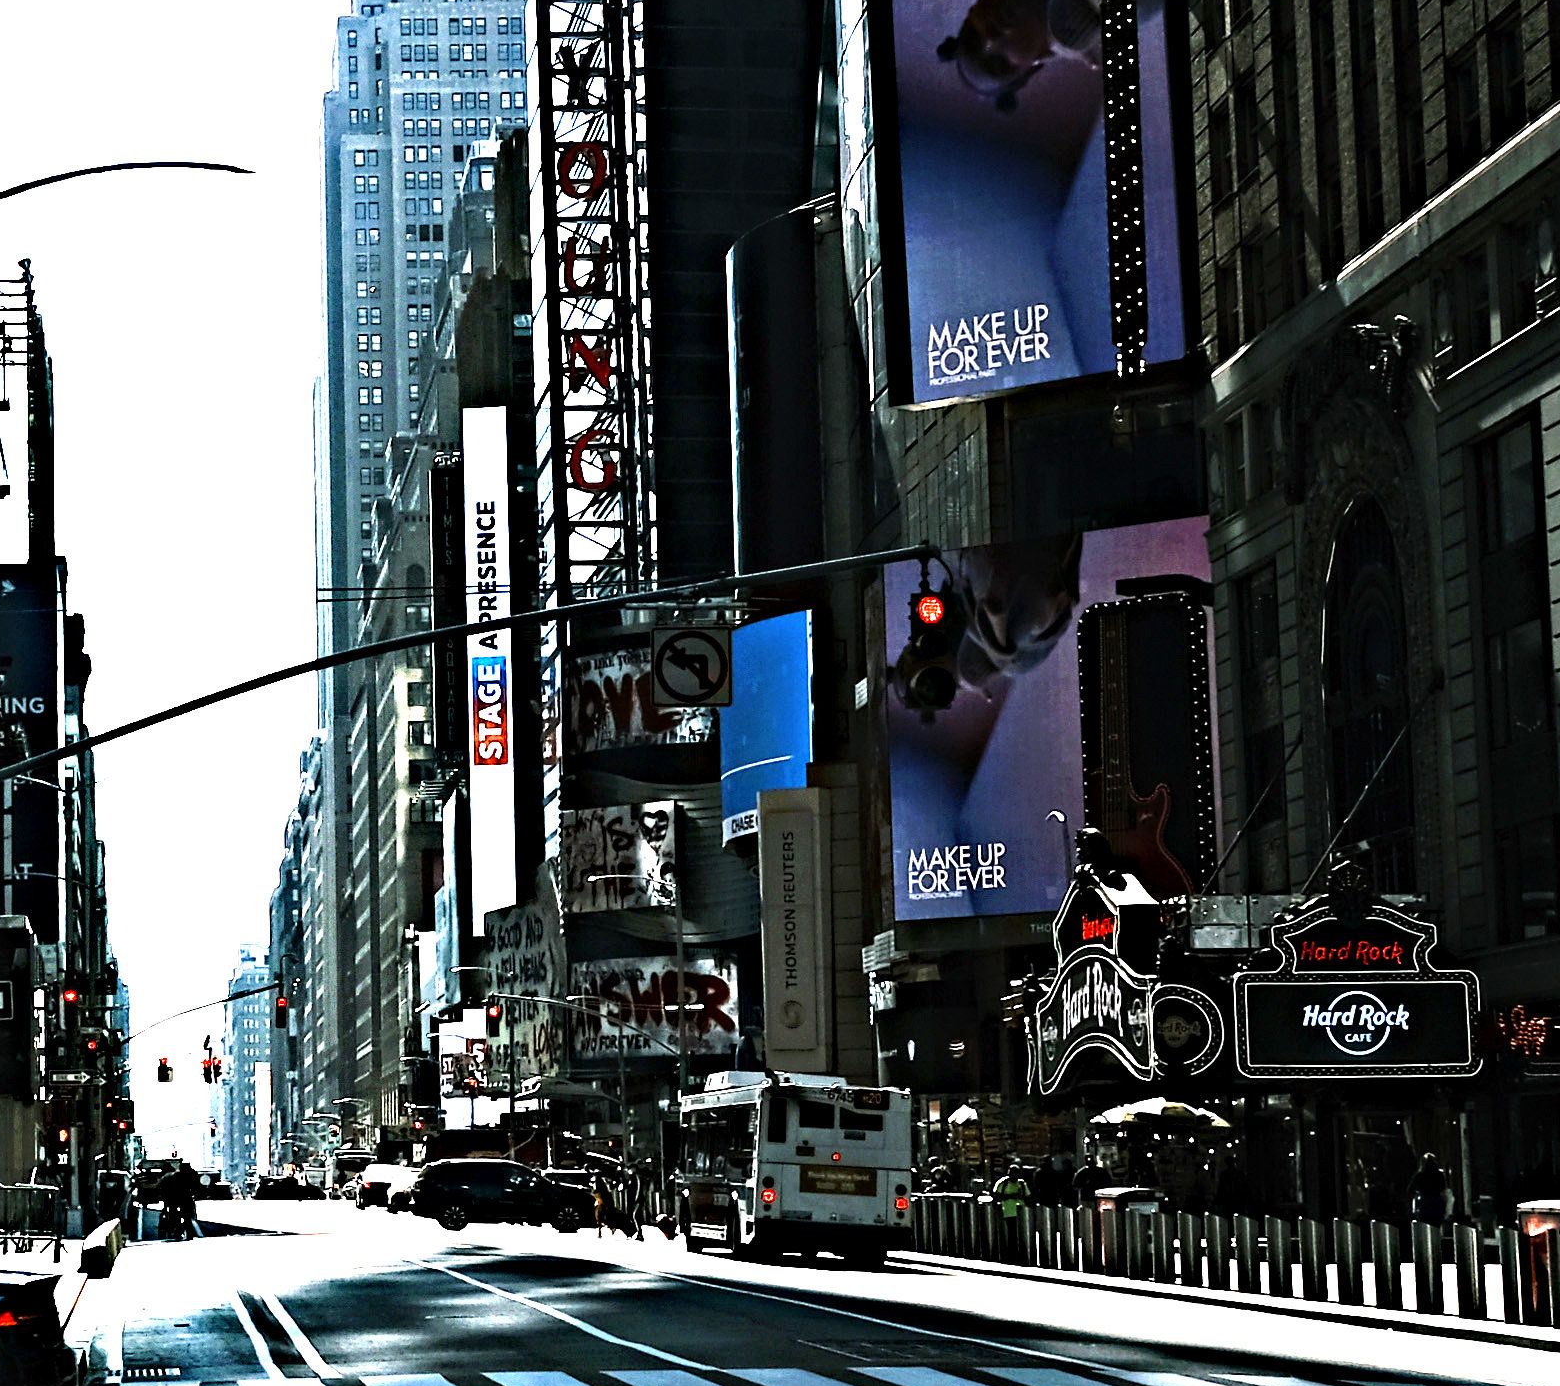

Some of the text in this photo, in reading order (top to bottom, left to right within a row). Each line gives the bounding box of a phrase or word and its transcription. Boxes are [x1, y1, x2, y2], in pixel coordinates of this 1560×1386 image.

[555, 43, 620, 494] YOUNG
[928, 302, 1050, 352] MAKE UP
[928, 329, 1051, 379] FOR EVER
[477, 663, 505, 761] STAGE
[908, 841, 1006, 872] MAKE UP
[908, 866, 1007, 895] FOR EVER
[783, 838, 798, 993] THOMSON REUTERS
[1299, 939, 1404, 967] Hard Rock
[1061, 965, 1091, 1041] Hard
[1093, 961, 1123, 1038] Rock
[1302, 1003, 1410, 1031] Hard Rock
[827, 1091, 854, 1104] 6745
